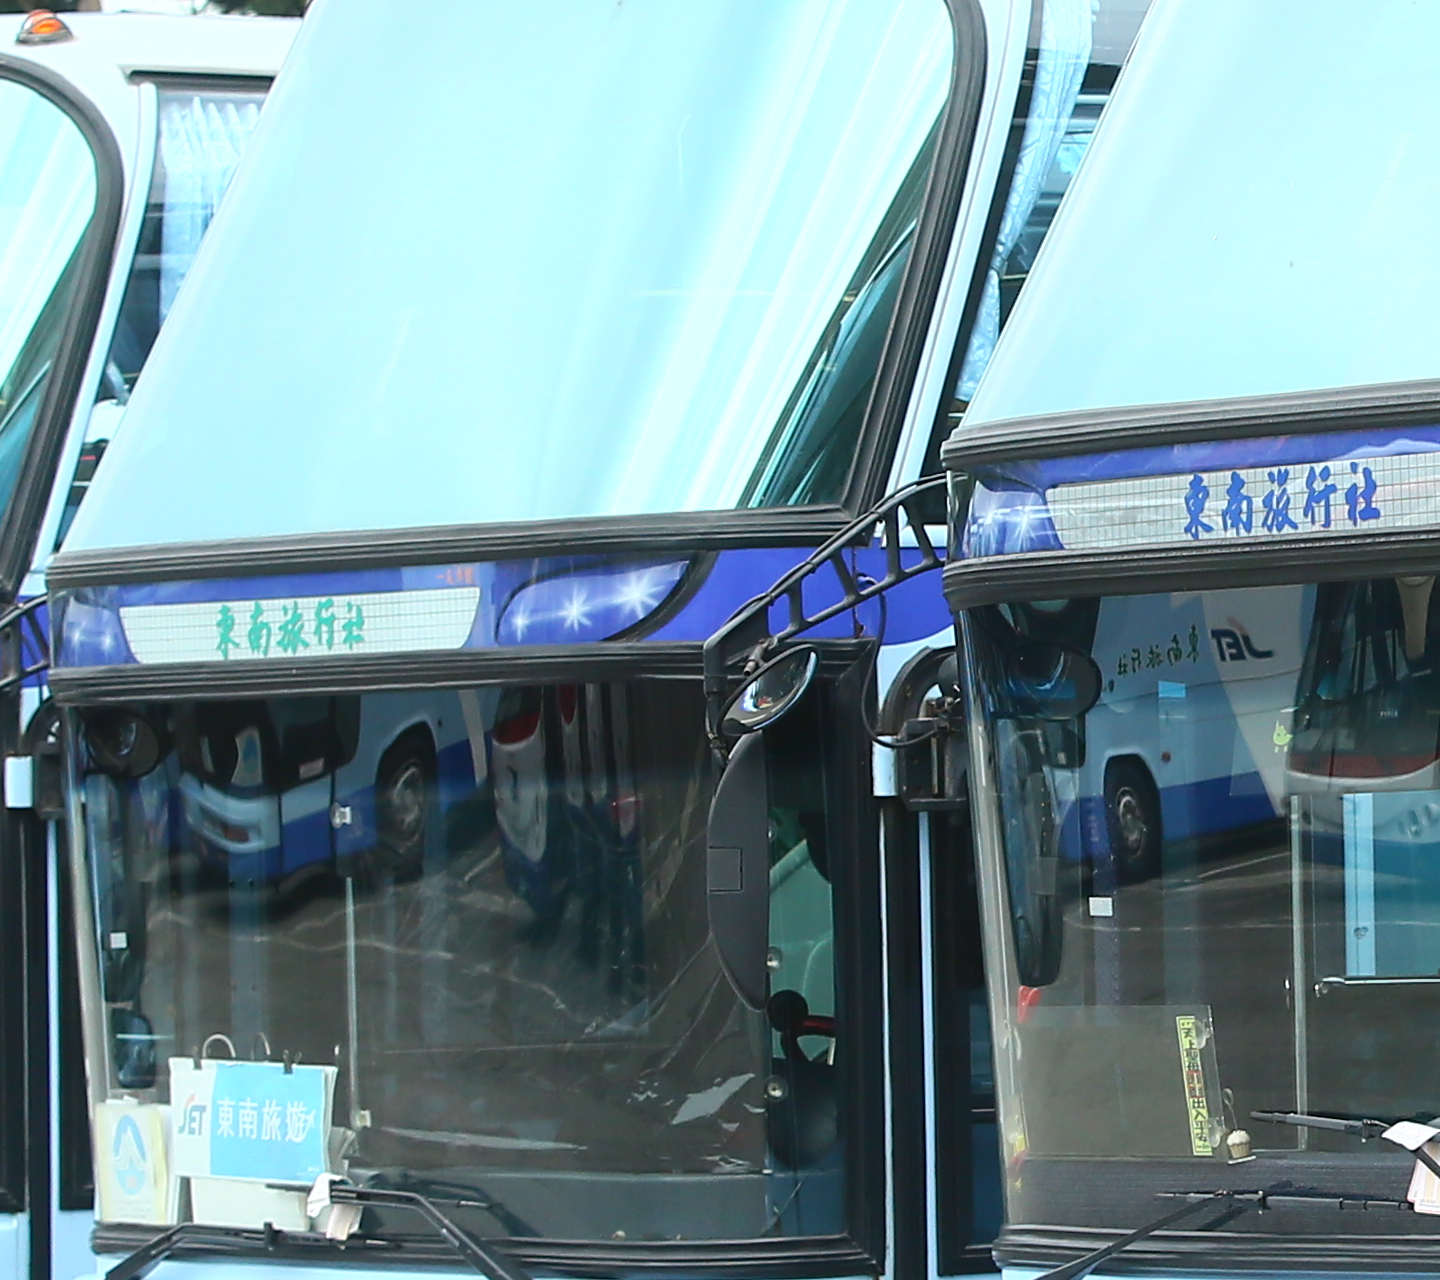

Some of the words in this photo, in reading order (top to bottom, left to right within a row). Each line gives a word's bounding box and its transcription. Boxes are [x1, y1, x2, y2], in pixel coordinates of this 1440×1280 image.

[1184, 461, 1381, 540] 東南旅行社
[216, 598, 365, 660] 東南旅行社
[178, 1093, 207, 1136] SET
[216, 1097, 312, 1144] 東南旅遊
